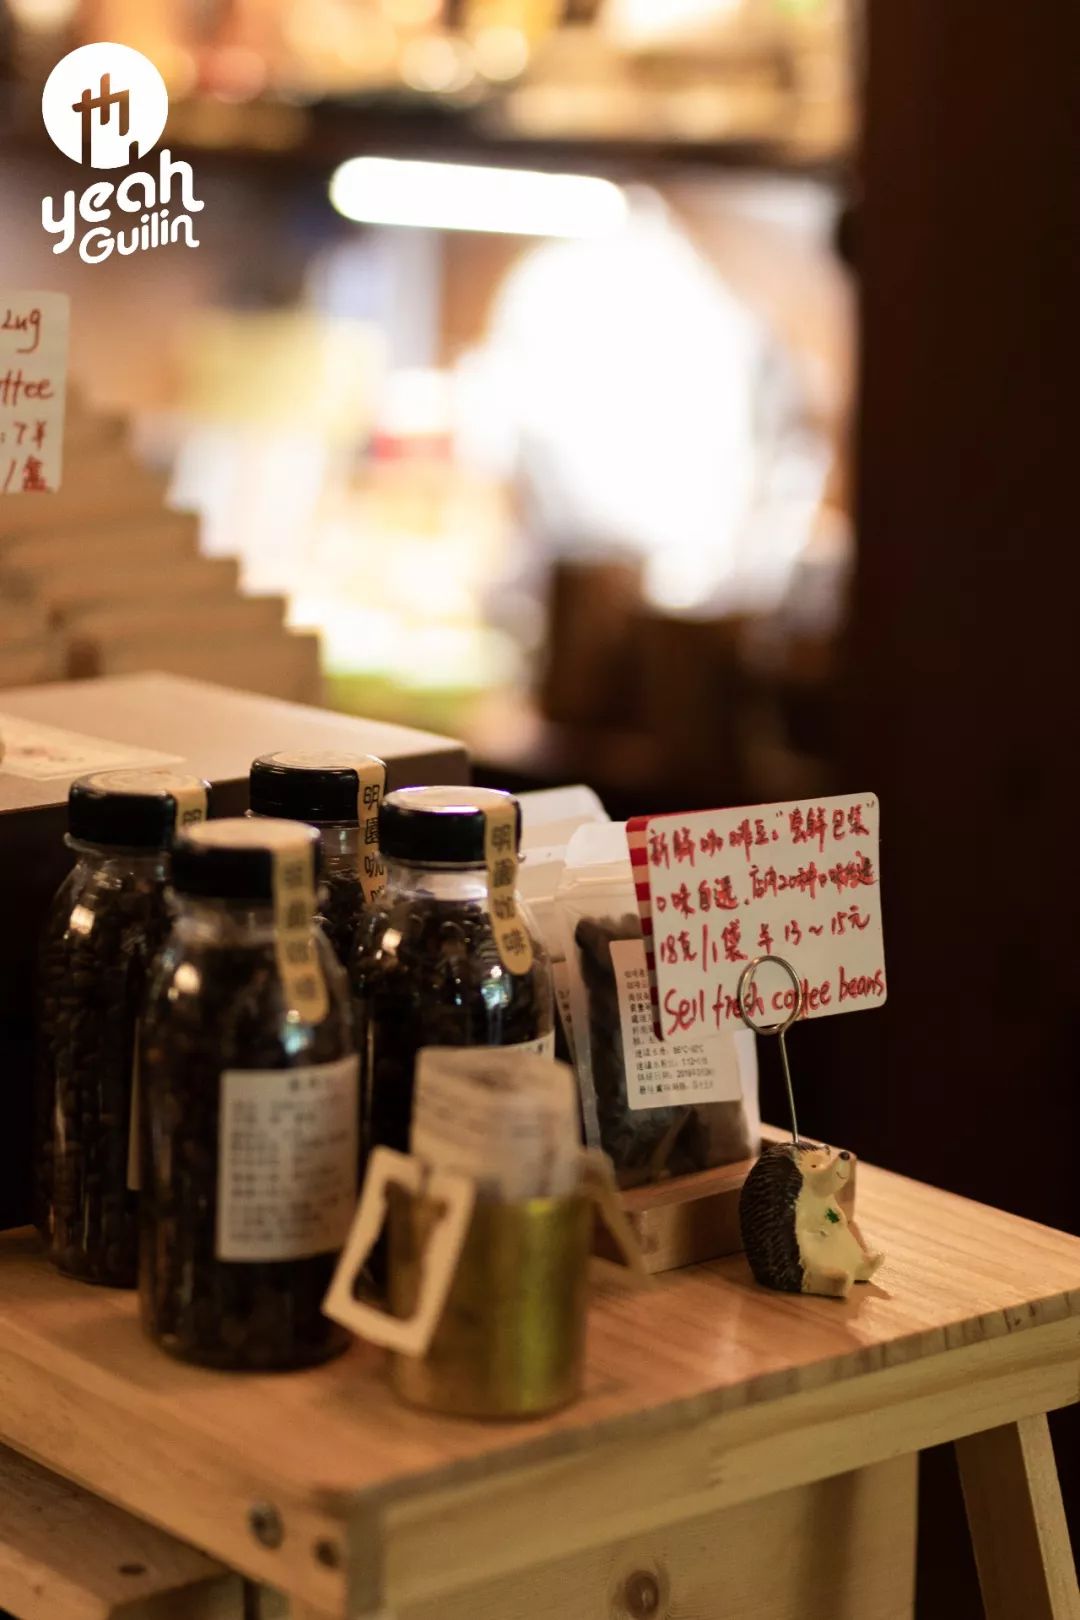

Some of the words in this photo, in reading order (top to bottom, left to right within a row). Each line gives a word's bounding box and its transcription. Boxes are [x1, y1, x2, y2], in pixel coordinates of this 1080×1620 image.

[0, 369, 54, 406] ffee
[664, 988, 705, 1036] Sell
[712, 983, 765, 1030] fresh
[838, 965, 885, 1003] beans
